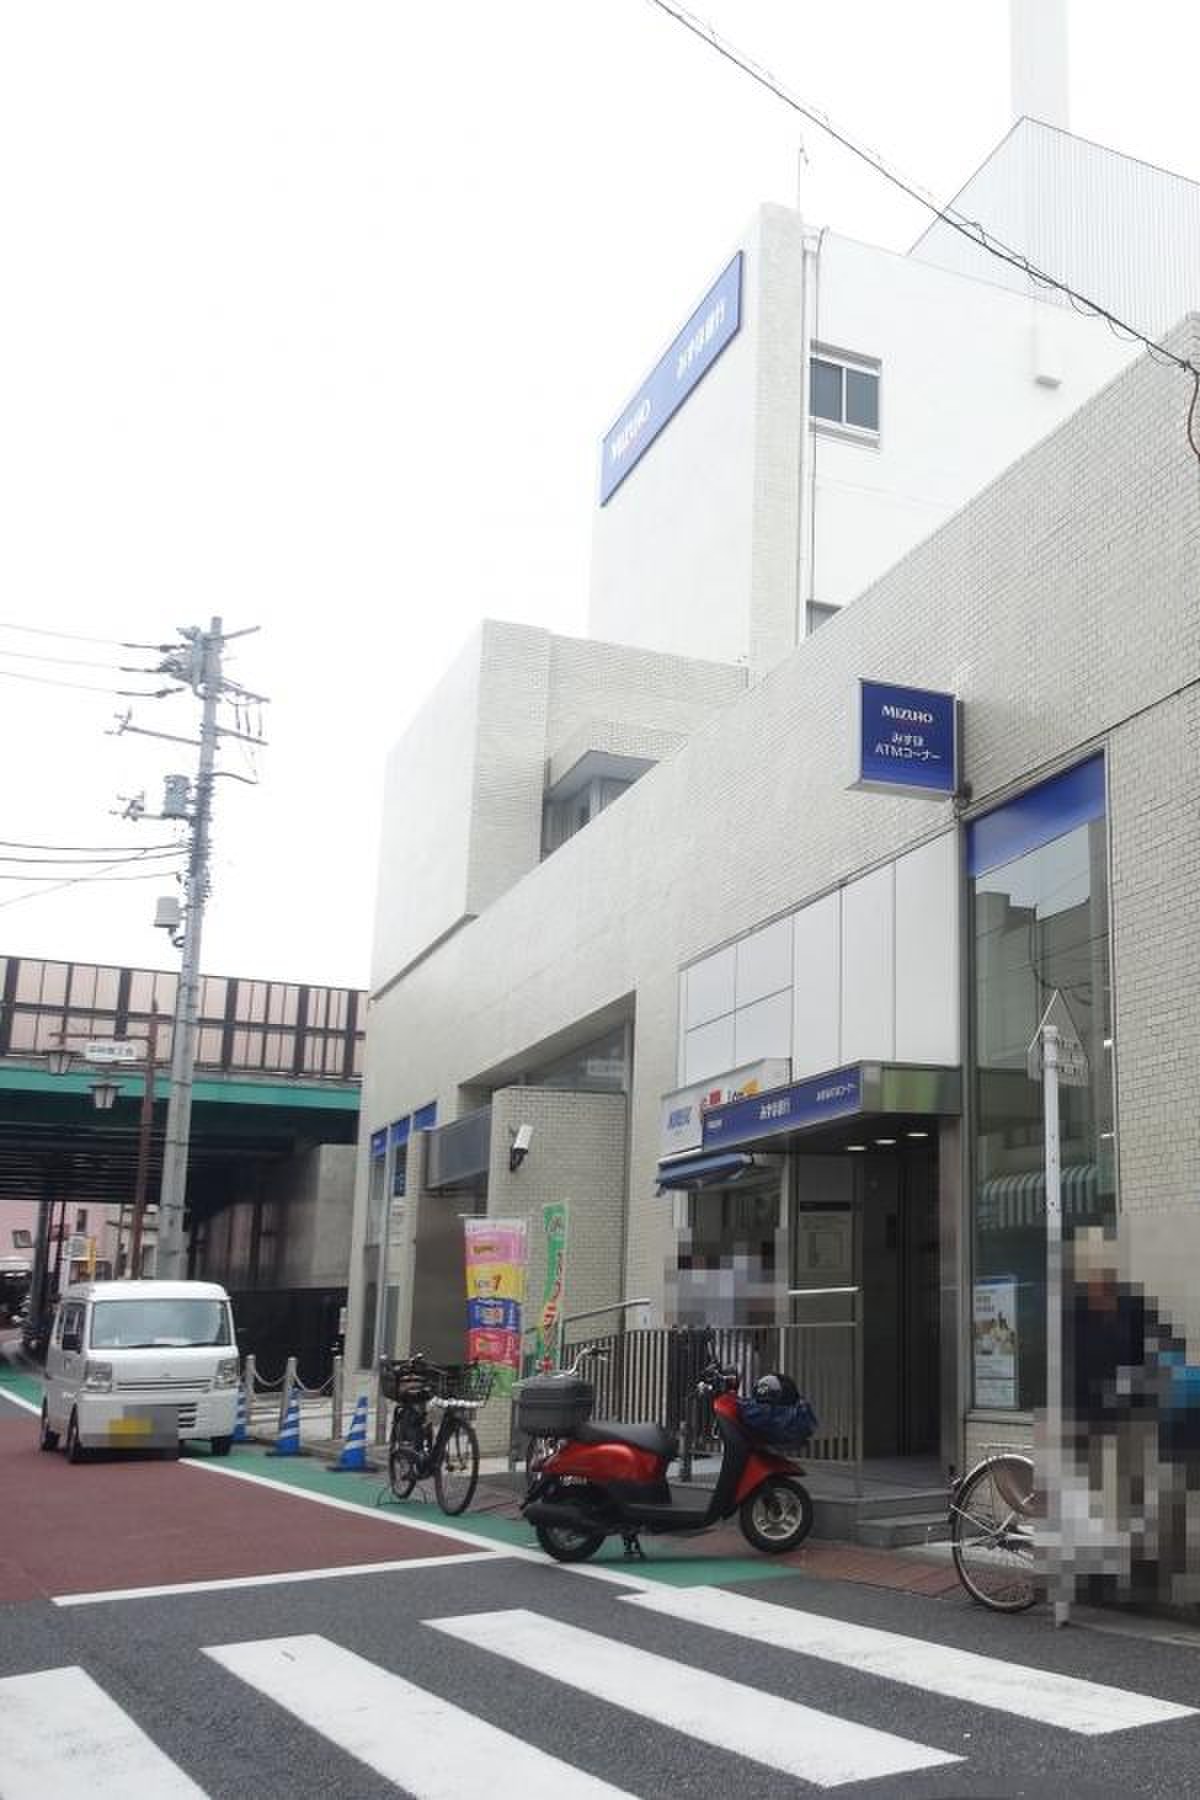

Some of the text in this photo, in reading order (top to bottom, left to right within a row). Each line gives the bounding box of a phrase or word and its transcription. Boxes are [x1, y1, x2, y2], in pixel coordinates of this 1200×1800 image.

[881, 704, 934, 724] MIZUHO
[874, 741, 942, 762] ATMコーナー
